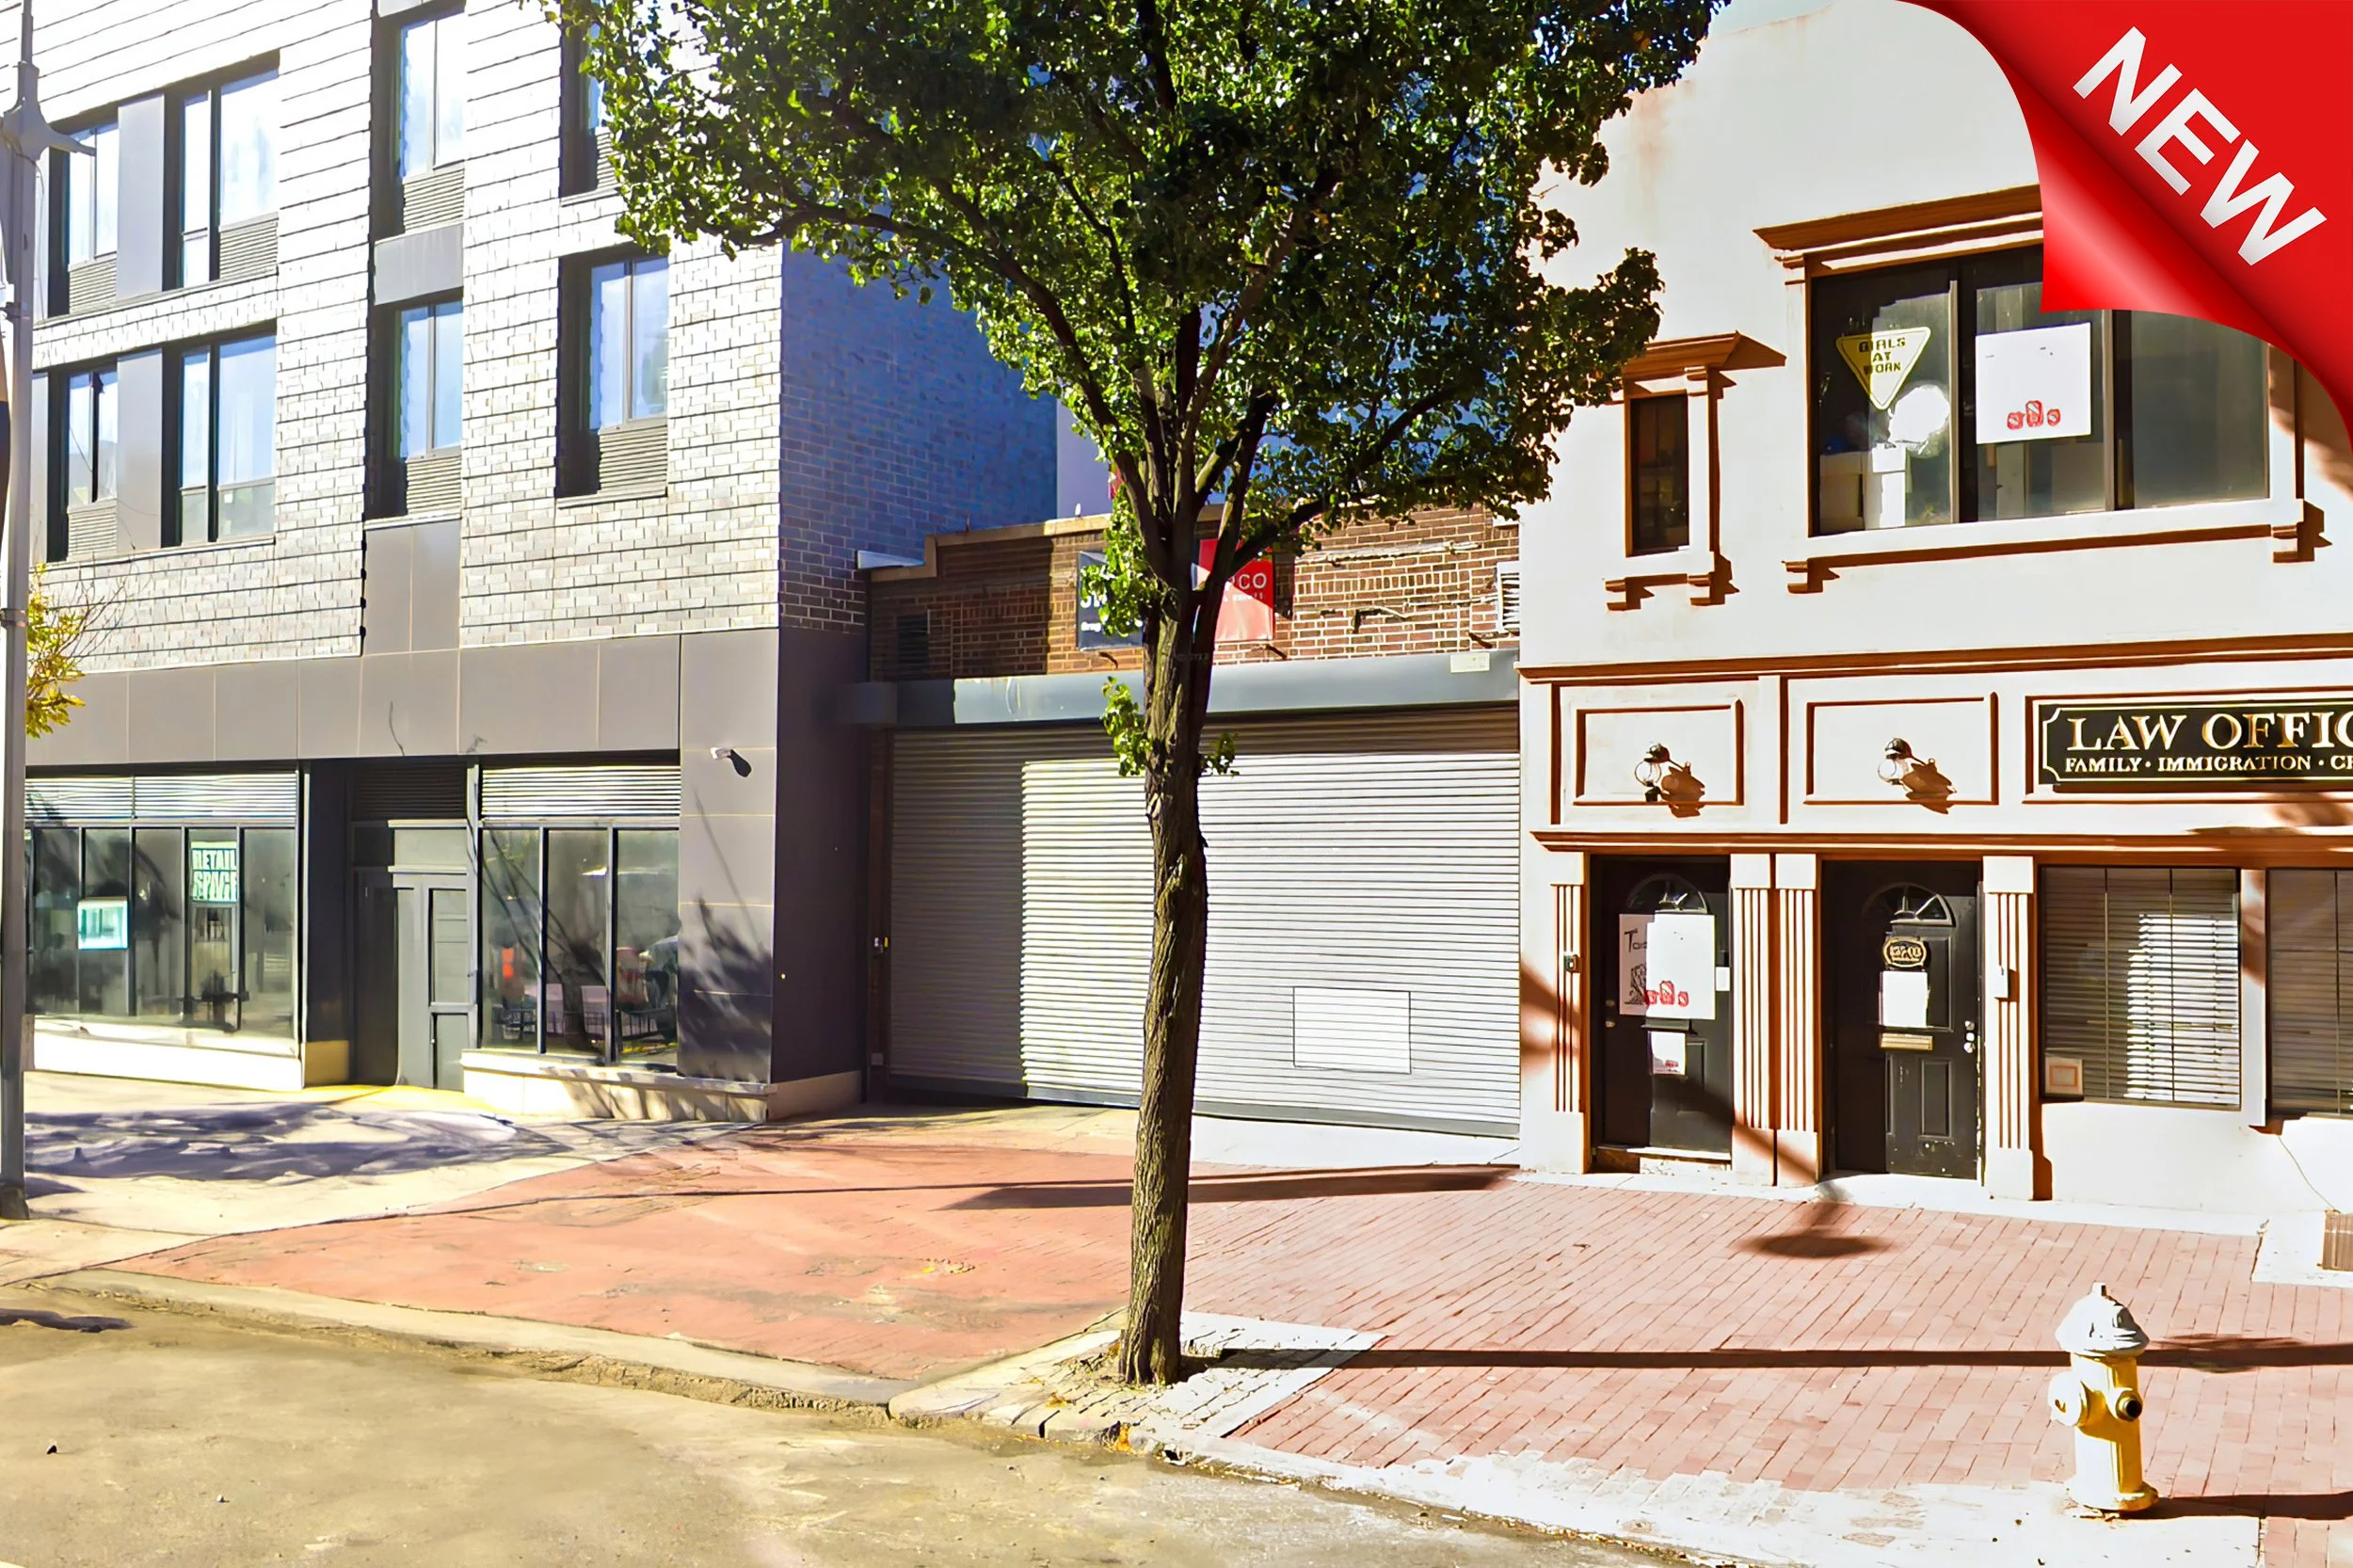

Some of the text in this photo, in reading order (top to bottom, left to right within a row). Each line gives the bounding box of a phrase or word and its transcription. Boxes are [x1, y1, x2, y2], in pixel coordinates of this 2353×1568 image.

[1859, 337, 1906, 353] GIRLS
[1873, 352, 1891, 361] AT
[2066, 714, 2187, 751] LAW
[2065, 756, 2141, 773] FAMILY
[2158, 755, 2312, 773] IMMIGRATION
[192, 849, 237, 871] RETAIL
[192, 871, 237, 901] SPACE
